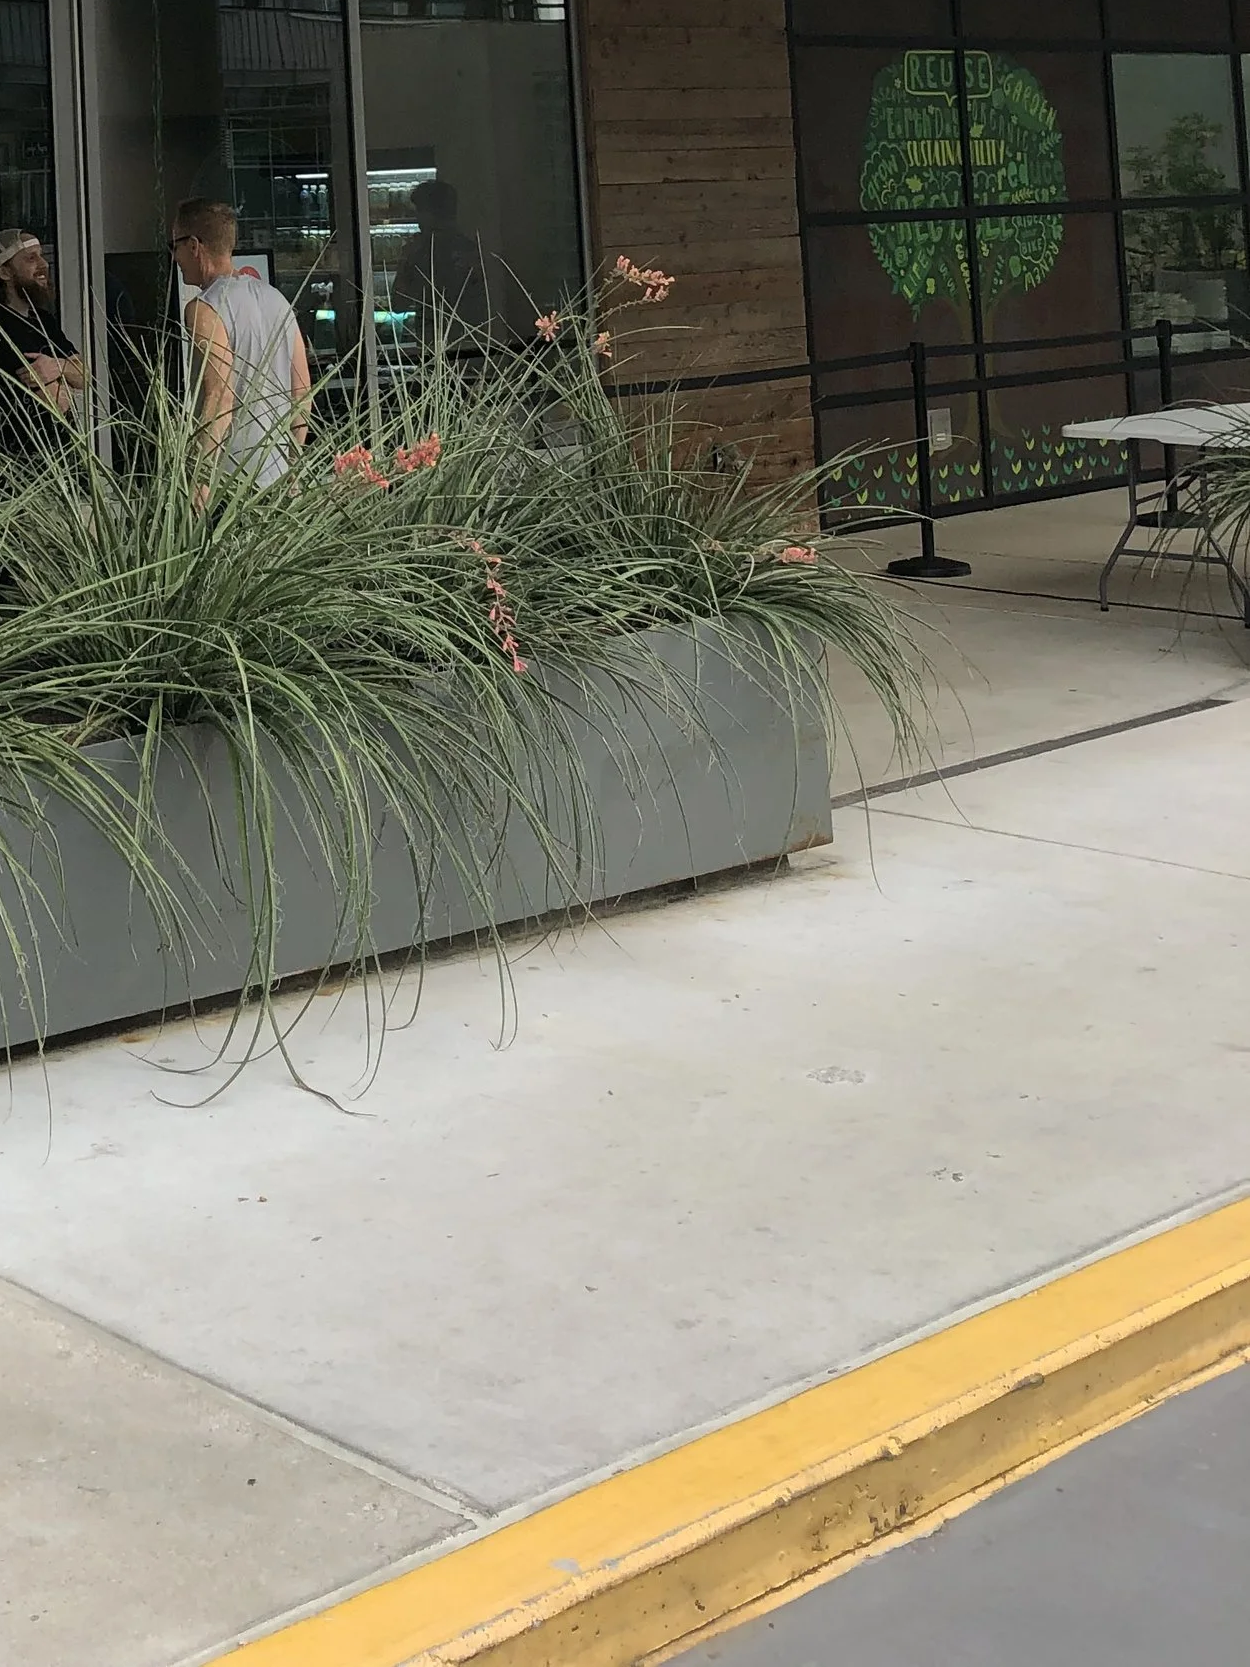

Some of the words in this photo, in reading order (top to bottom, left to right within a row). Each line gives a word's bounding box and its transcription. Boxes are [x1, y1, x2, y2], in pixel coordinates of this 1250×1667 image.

[909, 55, 990, 91] REUSE
[1003, 73, 1058, 130] GARDEN
[906, 139, 1005, 166] SUSTAINAILITY
[1021, 237, 1043, 255] BIKE
